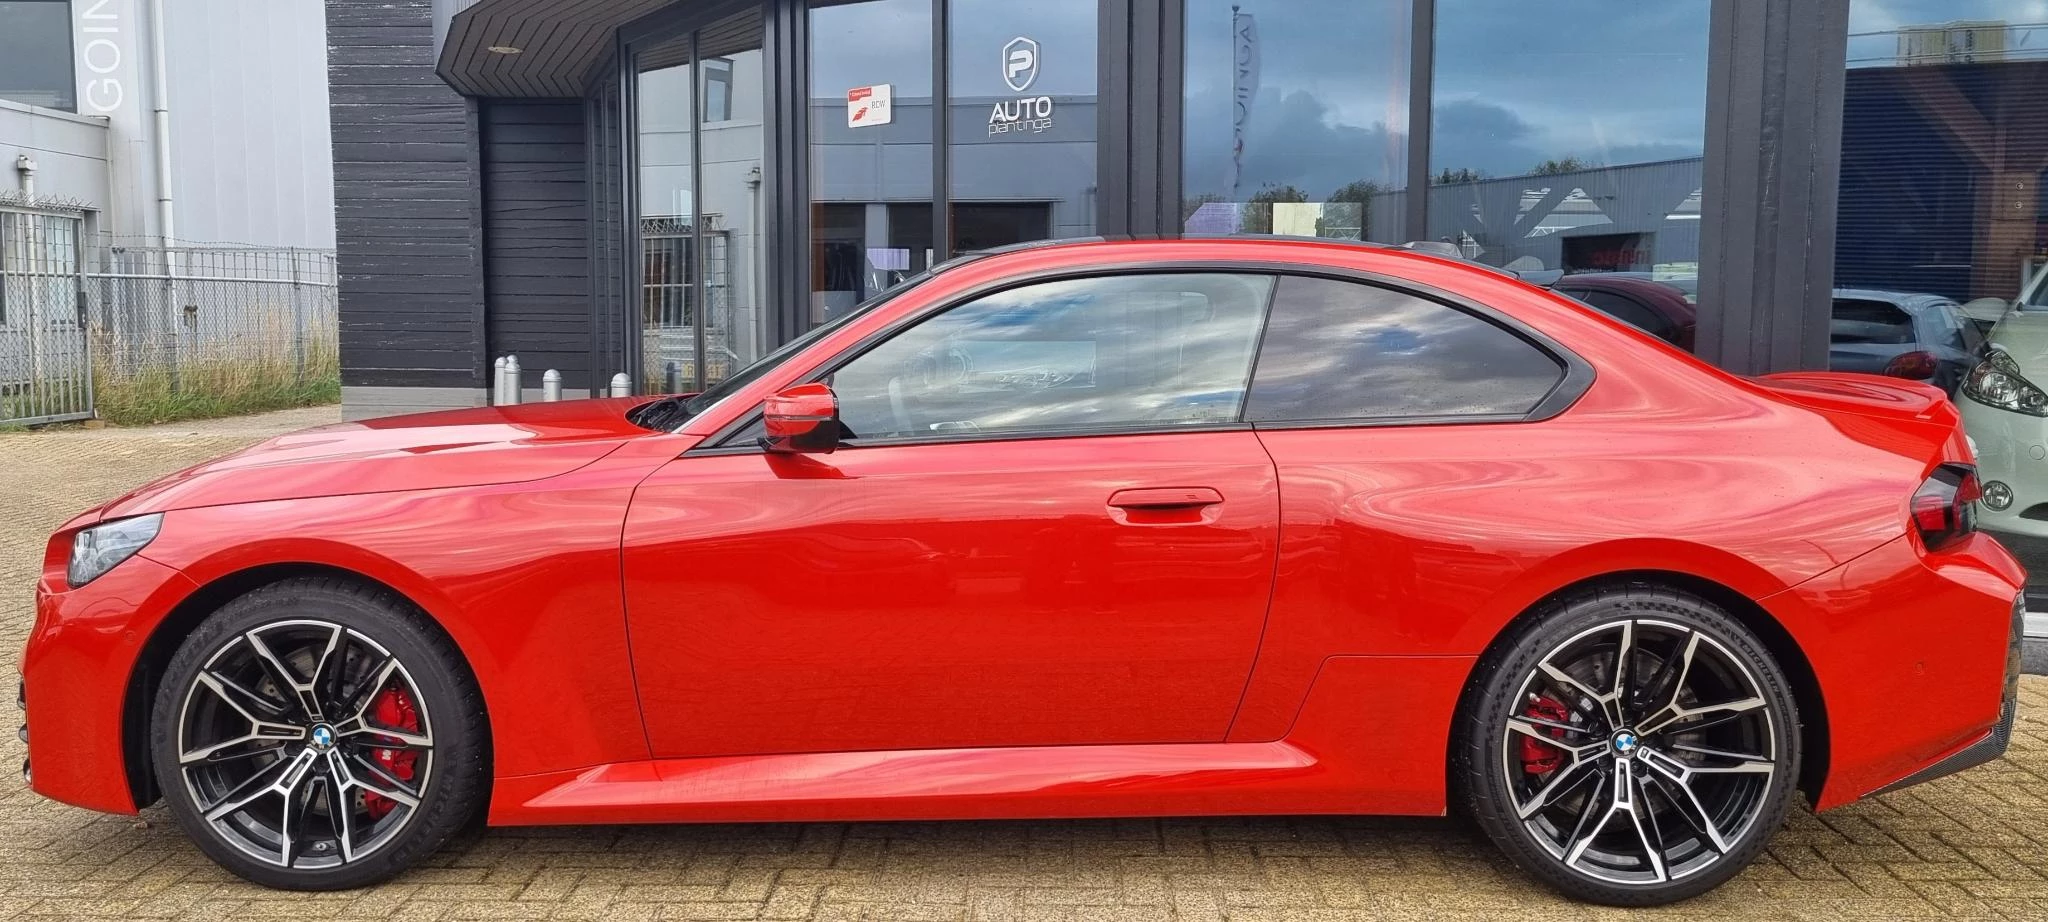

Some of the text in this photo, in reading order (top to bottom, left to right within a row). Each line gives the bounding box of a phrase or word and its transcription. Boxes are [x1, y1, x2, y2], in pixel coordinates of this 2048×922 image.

[989, 96, 1052, 123] AUTO
[988, 117, 1052, 138] plantinga
[1743, 643, 1779, 692] MICHELIN
